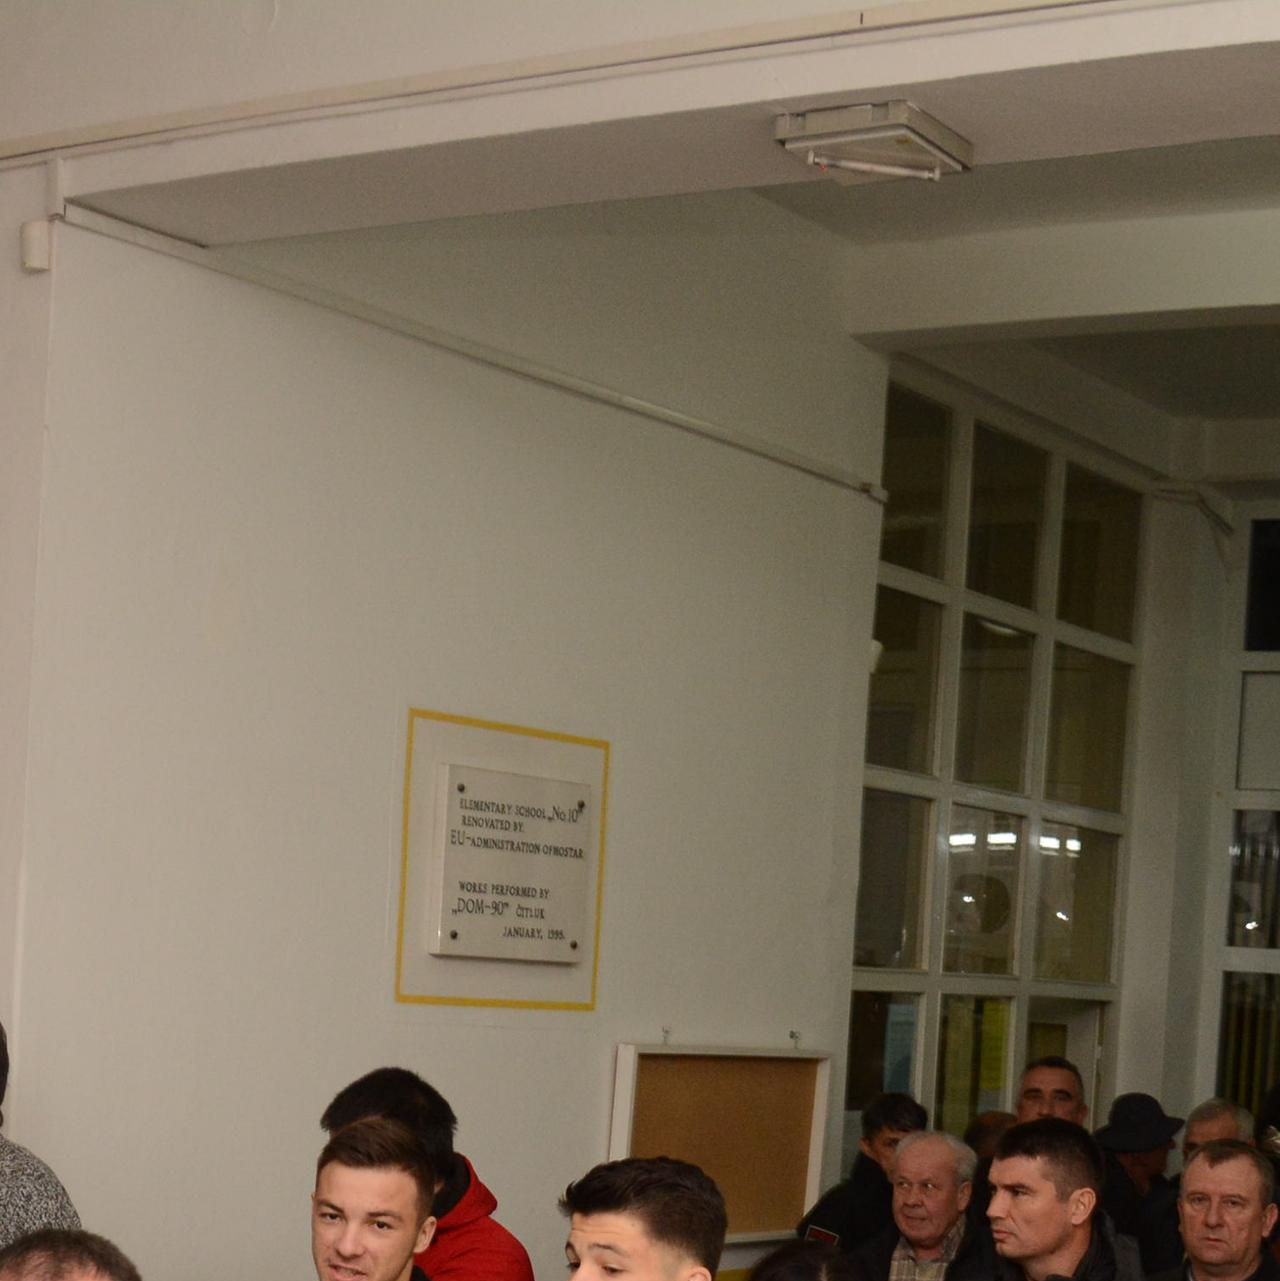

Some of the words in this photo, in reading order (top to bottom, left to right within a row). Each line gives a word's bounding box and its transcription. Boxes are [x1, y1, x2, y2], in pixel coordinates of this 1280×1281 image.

[459, 798, 513, 816] ELEMENTARY
[515, 805, 546, 820] SCHOOL
[461, 815, 511, 831] RENOVATED
[458, 880, 488, 894] WORKS
[491, 883, 537, 897] PERFORMED
[502, 926, 543, 940] JANUARY,
